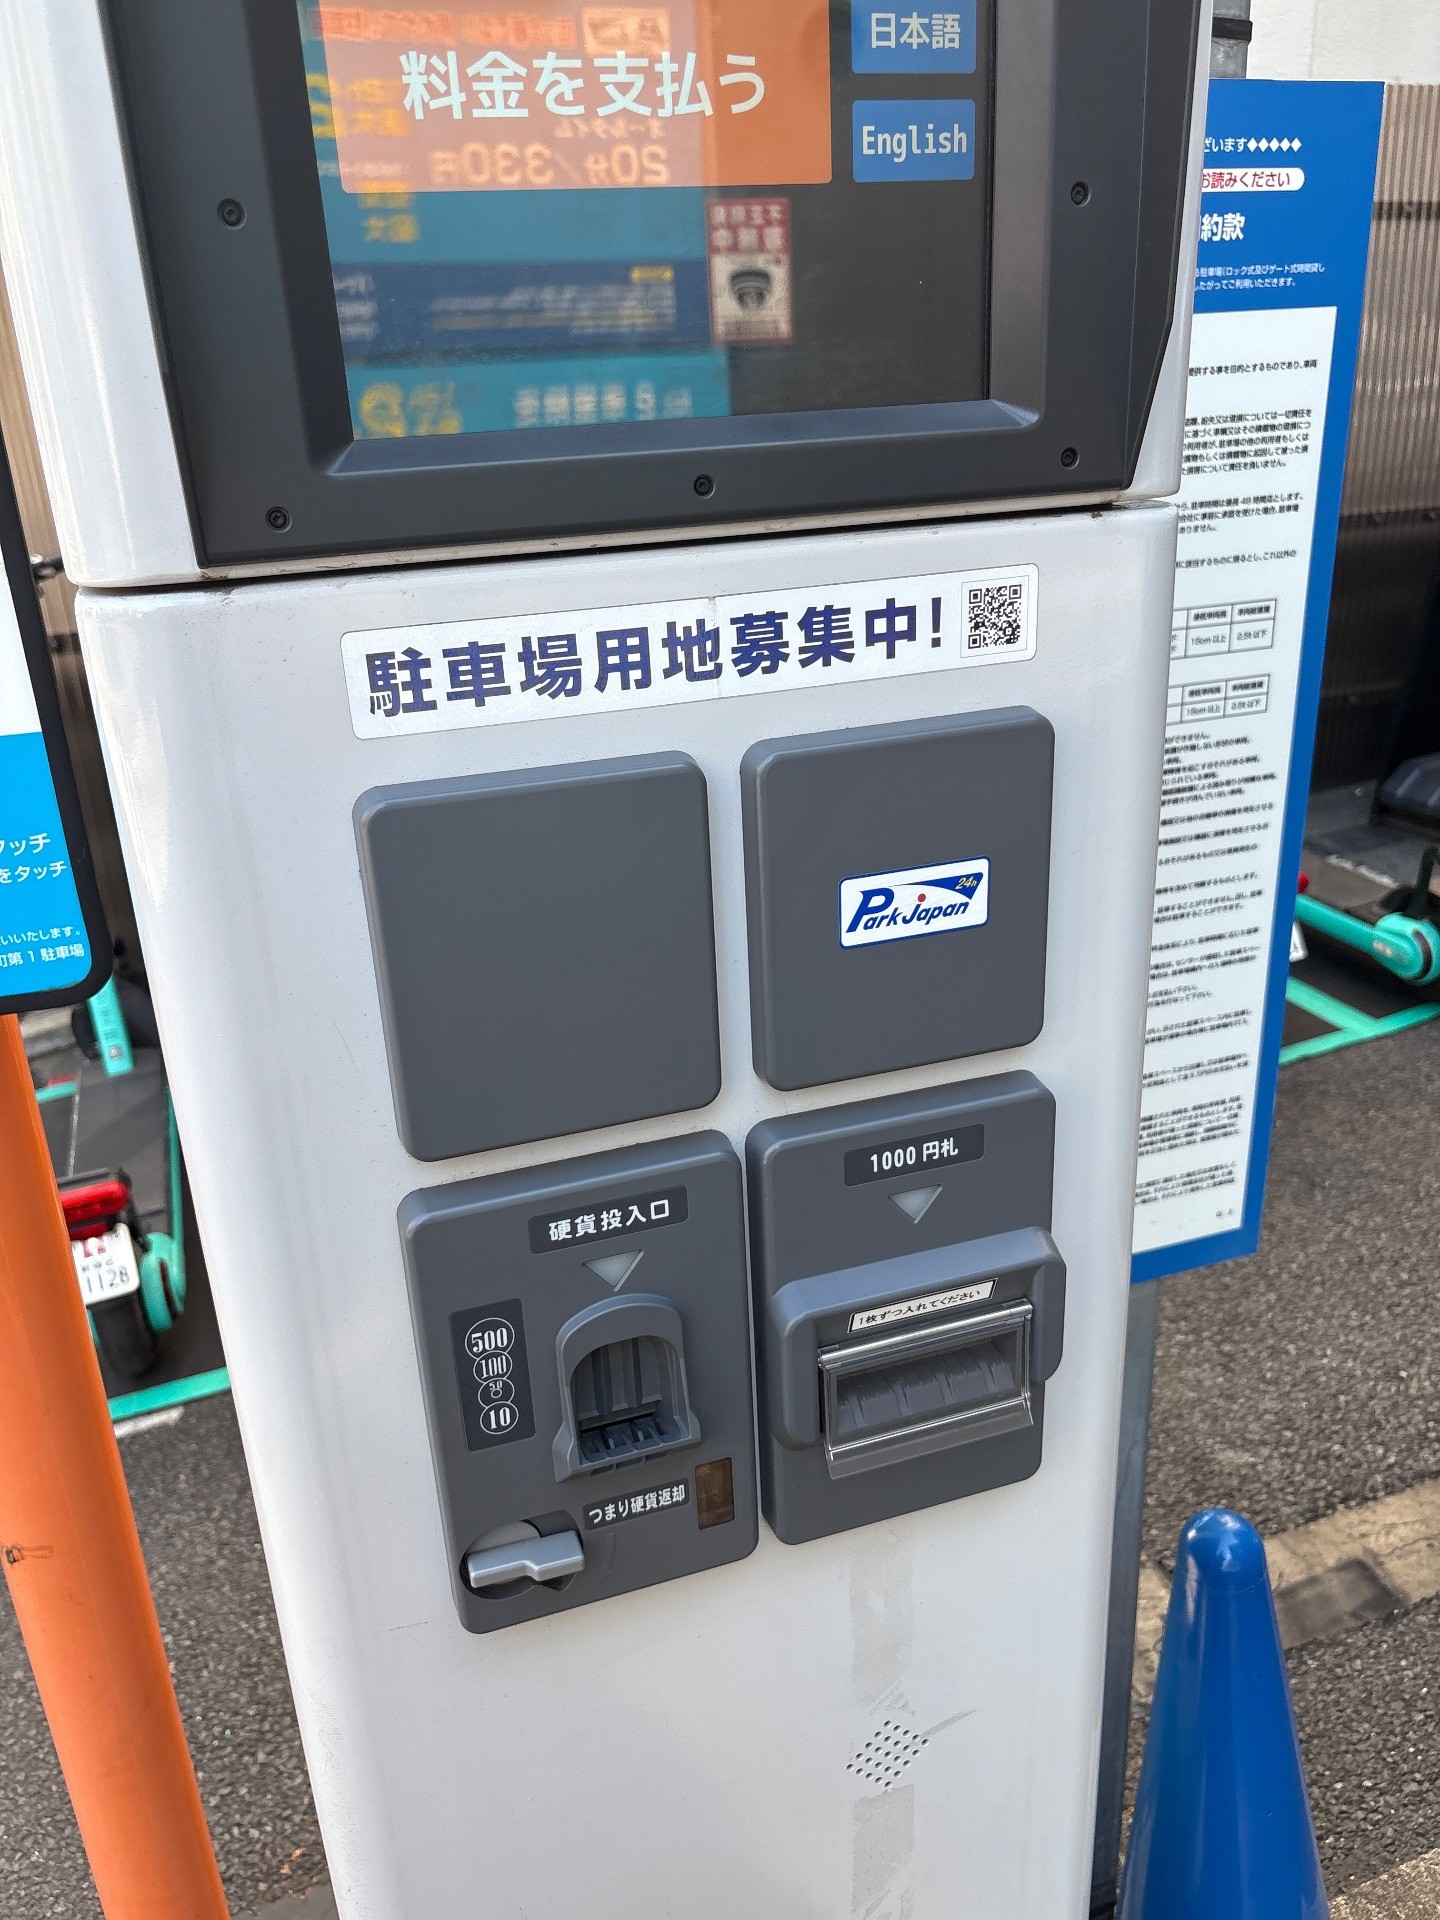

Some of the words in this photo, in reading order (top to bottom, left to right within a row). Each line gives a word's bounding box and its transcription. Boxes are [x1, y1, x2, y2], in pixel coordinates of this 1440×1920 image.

[870, 12, 961, 50] 日本語
[399, 50, 766, 120] 料金を支払う
[862, 123, 967, 163] English
[1201, 171, 1290, 189] お読みください
[365, 597, 942, 718] 駐車場用地募集中!
[0, 860, 68, 884] をタッチ
[955, 876, 977, 890] 24h
[846, 887, 903, 933] Park
[902, 893, 970, 926] Japan
[0, 925, 81, 946] いいたします。
[870, 1145, 917, 1173] 1000
[548, 1199, 670, 1241] 硬貨投入口
[859, 1289, 981, 1325] 1枚ずつ入れてください
[471, 1327, 508, 1353] 500
[479, 1355, 507, 1380] 100
[489, 1380, 503, 1391] 50
[489, 1406, 511, 1430] 10
[588, 1484, 686, 1524] つまり硬貨返却
